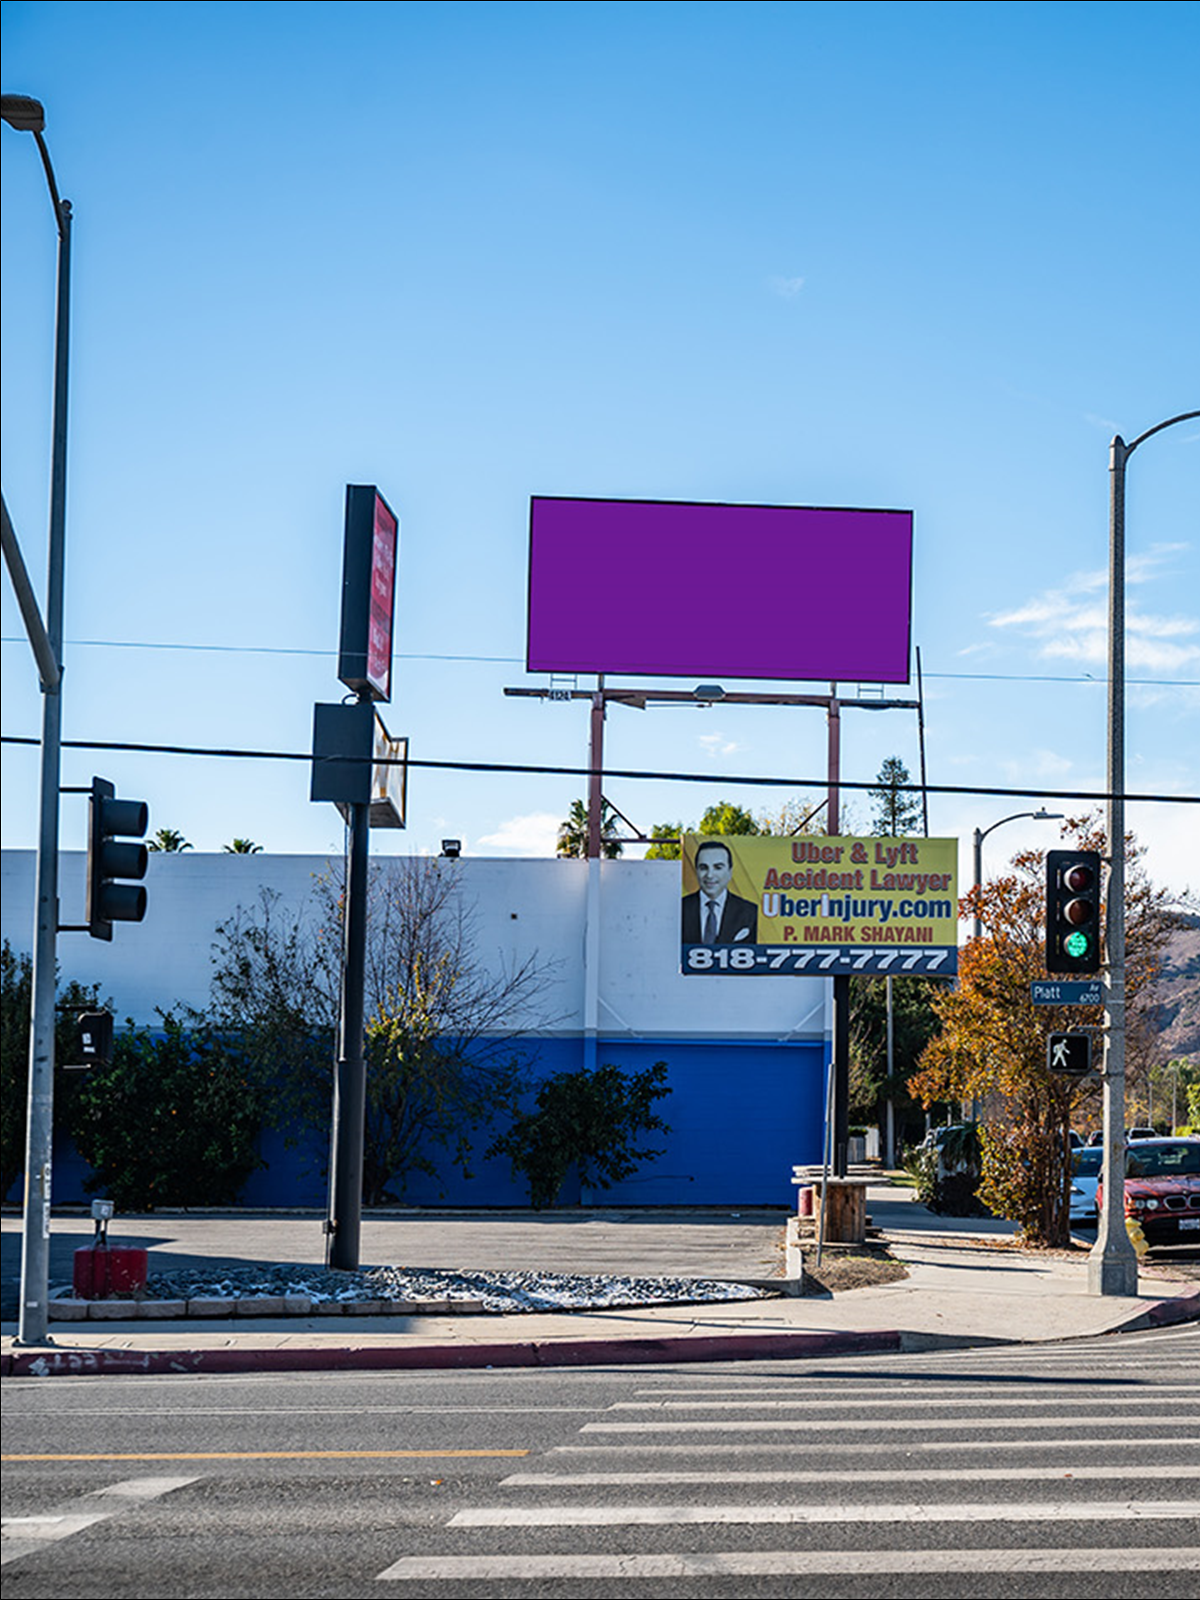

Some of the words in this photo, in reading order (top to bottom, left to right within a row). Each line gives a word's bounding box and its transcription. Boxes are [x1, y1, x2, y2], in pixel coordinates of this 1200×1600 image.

[791, 842, 844, 863] Uber
[850, 843, 868, 863] &
[874, 842, 918, 868] Lyft
[763, 868, 863, 890] Accident
[870, 869, 952, 895] Lawyer
[762, 893, 951, 922] UberInjury.com
[783, 926, 798, 942] P.
[804, 926, 855, 942] MARK
[861, 926, 933, 943] SHAYANI
[687, 948, 948, 970] 818-777-7777
[1034, 985, 1060, 999] Platt
